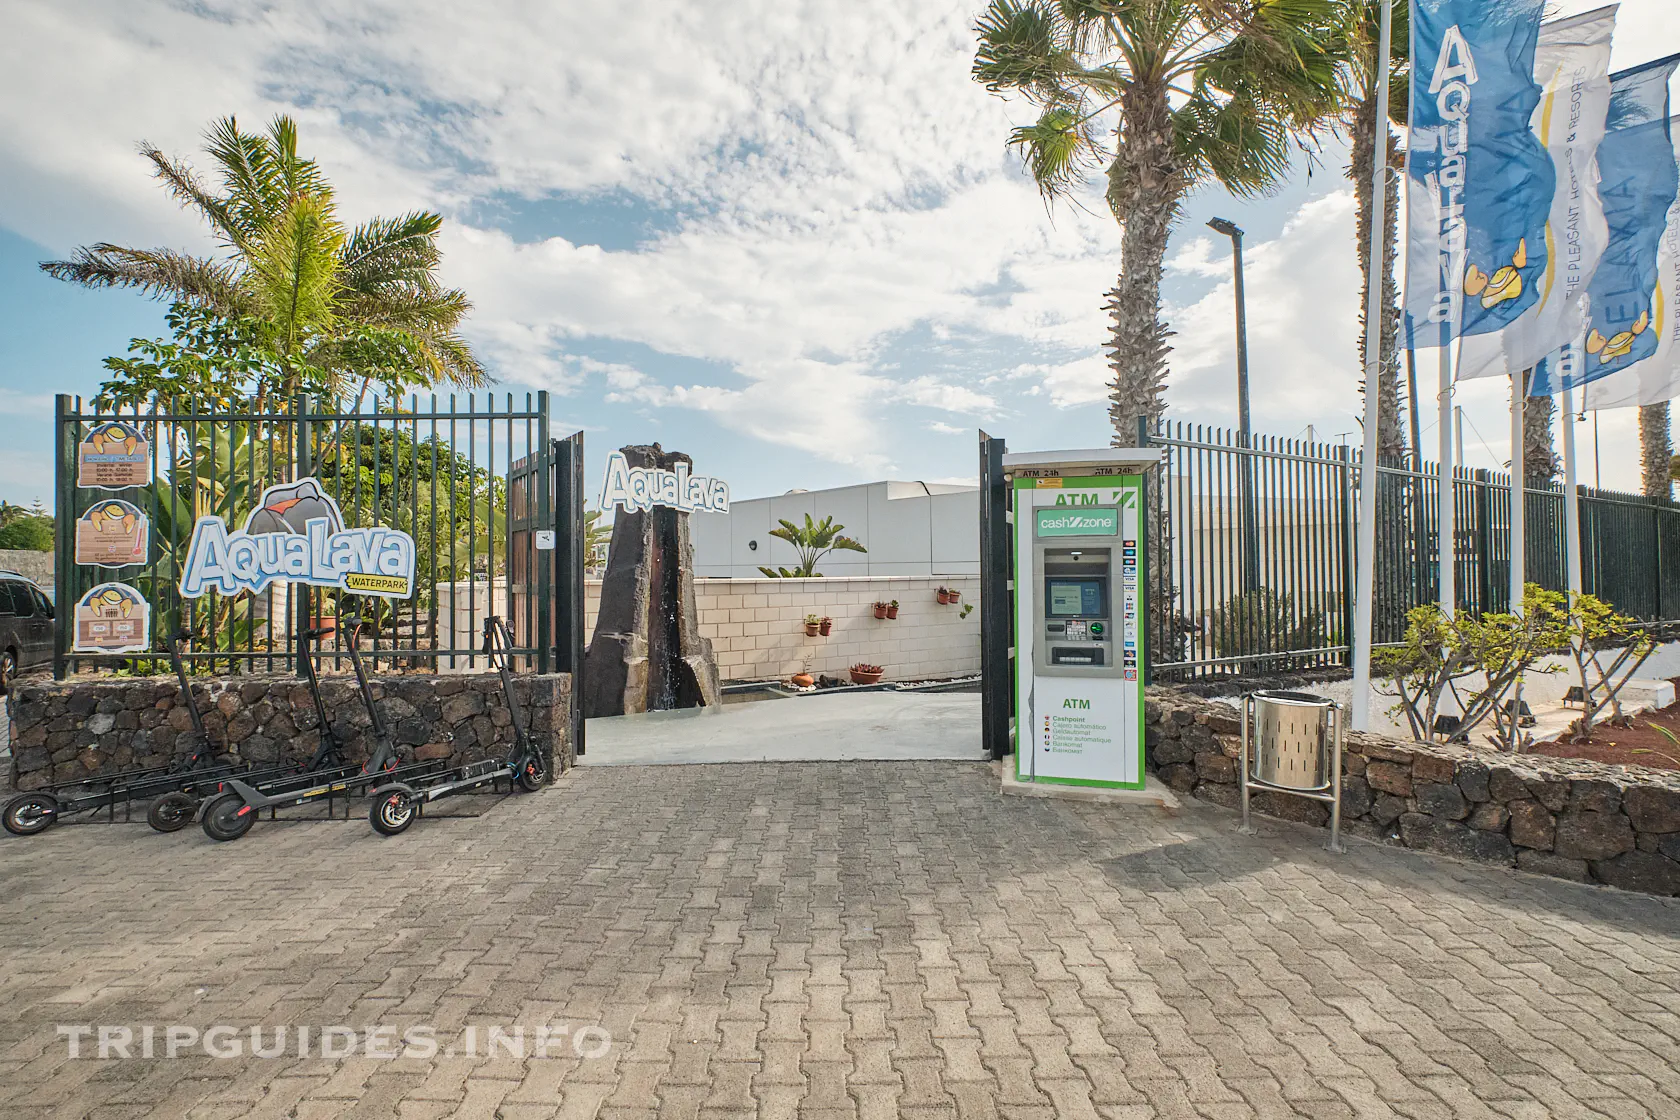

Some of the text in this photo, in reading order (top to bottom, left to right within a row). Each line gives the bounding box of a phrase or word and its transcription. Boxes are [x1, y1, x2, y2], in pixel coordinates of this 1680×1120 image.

[1568, 65, 1587, 131] RESORTS
[1567, 132, 1577, 143] &
[1567, 206, 1581, 271] PLEASANT
[1566, 275, 1580, 301] THE
[1043, 469, 1059, 477] 24h
[1117, 467, 1133, 475] 24h
[1055, 493, 1099, 506] ATM
[351, 577, 405, 590] WATERPARK
[1063, 698, 1091, 710] ATM
[1052, 715, 1085, 723] Cashpoint
